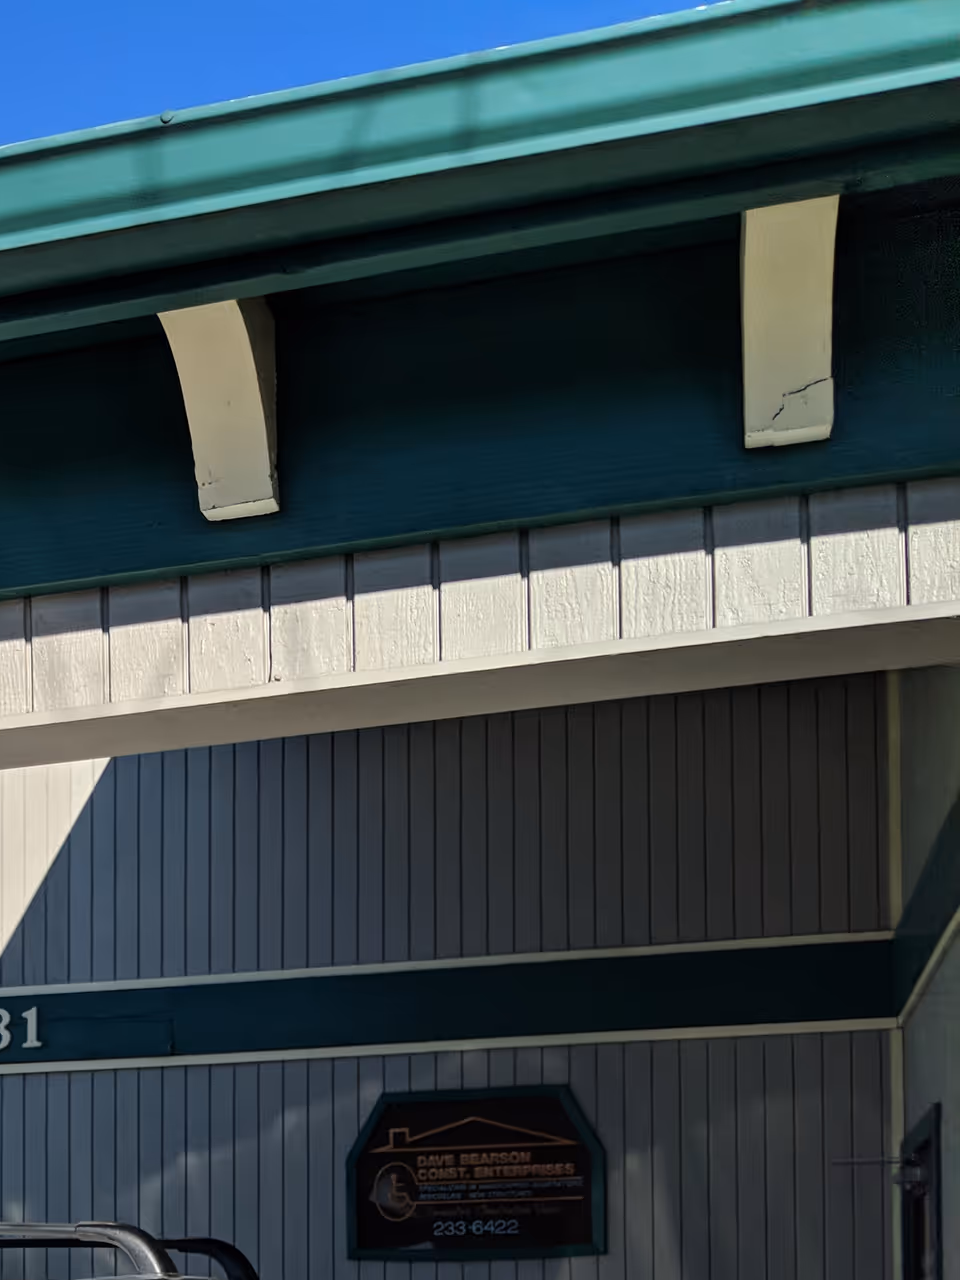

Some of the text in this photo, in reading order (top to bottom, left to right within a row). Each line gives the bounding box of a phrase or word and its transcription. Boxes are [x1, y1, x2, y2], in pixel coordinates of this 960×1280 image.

[416, 1153, 455, 1168] DAVE
[416, 1162, 576, 1181] CONST. ENTERPRISES
